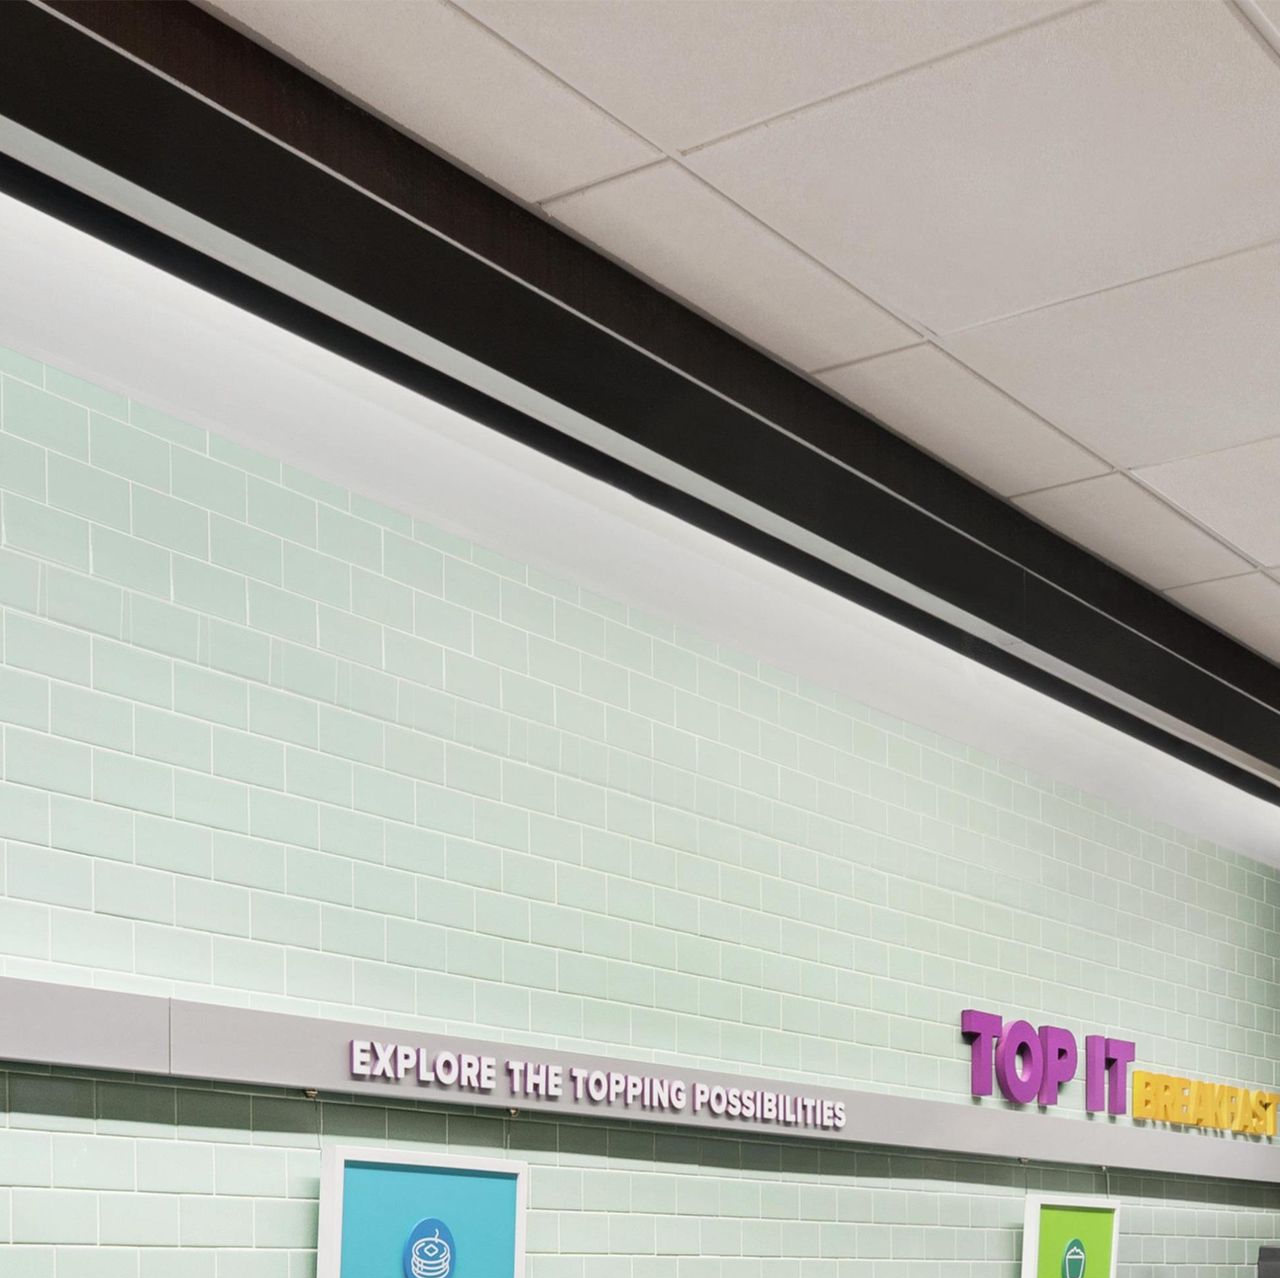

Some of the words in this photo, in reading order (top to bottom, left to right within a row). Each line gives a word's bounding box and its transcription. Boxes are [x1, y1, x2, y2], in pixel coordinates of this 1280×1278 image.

[350, 1040, 496, 1089] EXPLORE
[506, 1060, 563, 1097] THE
[570, 1068, 686, 1109] TOPPING
[692, 1083, 846, 1129] POSSIBILITIES
[961, 1009, 1077, 1106] TOP
[1085, 1034, 1136, 1115] IT
